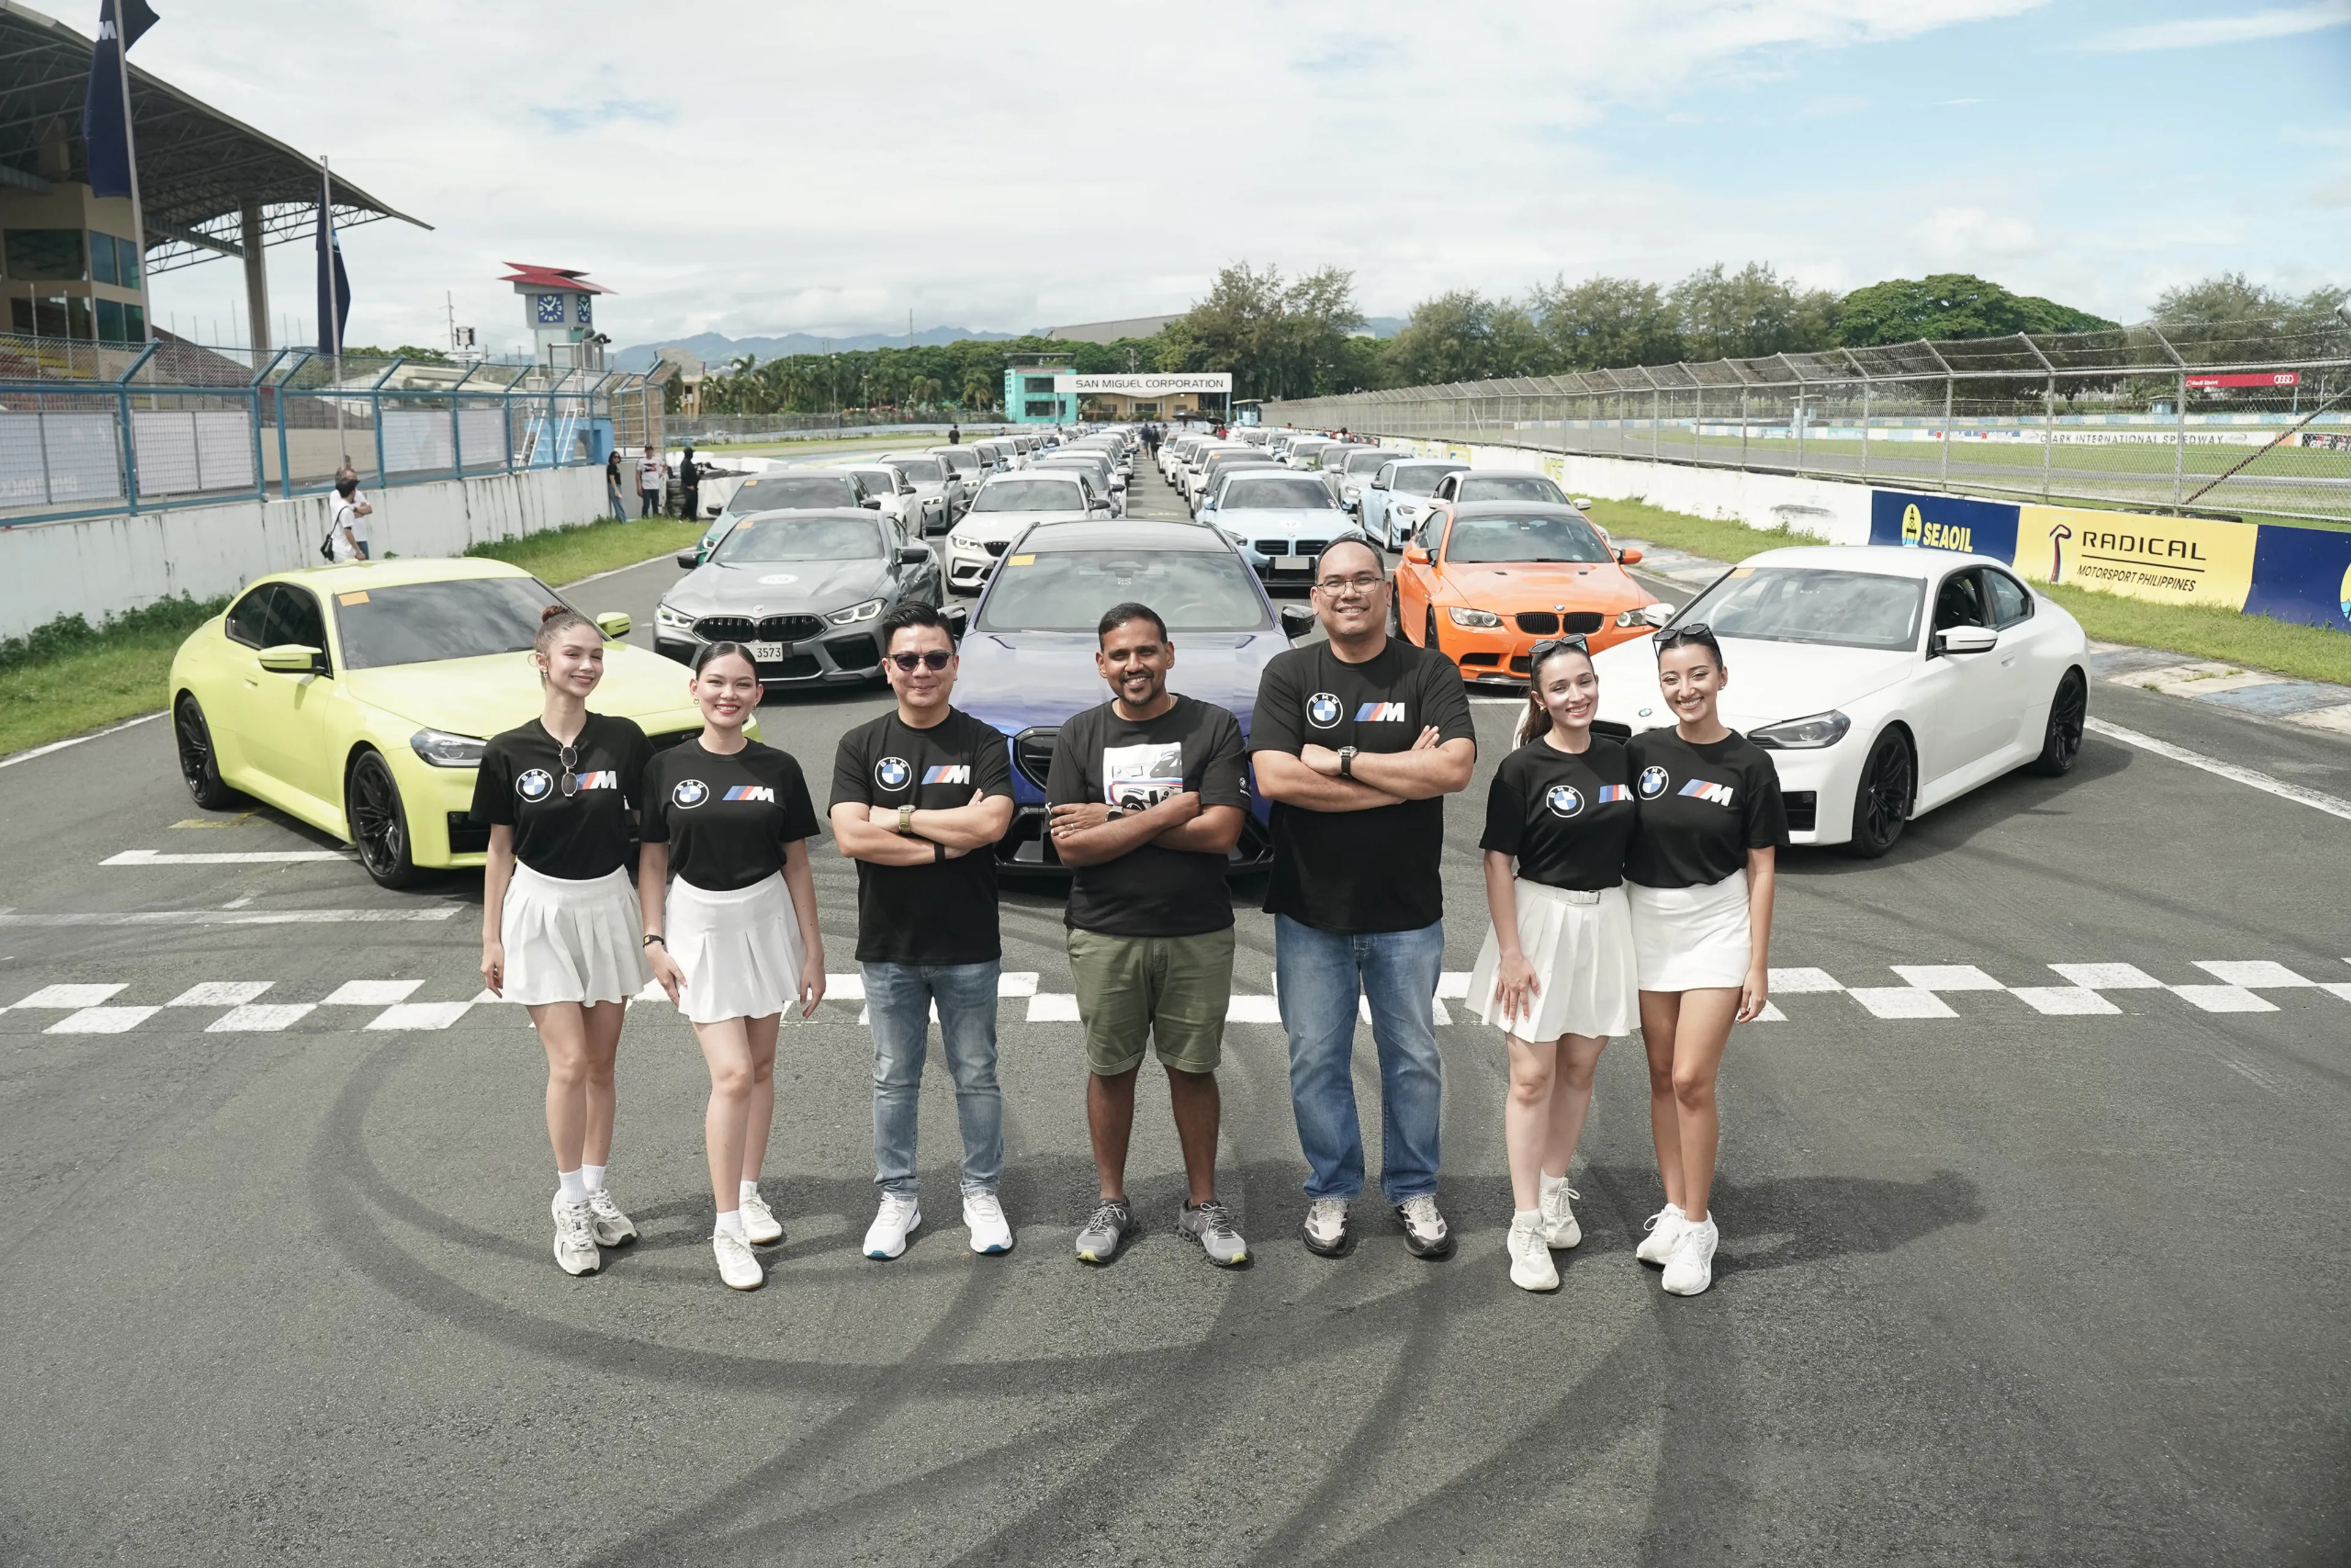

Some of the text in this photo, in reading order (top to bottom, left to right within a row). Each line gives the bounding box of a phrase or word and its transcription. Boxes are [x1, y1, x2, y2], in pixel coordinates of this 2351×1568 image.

[1076, 379, 1223, 388] SAN MIGUEL CORPORATION
[2040, 434, 2072, 443] CARK
[2076, 434, 2157, 444] INTERNATIONAL
[2163, 435, 2224, 445] SPEDWAY
[1923, 522, 1973, 553] SEAOIL
[2083, 531, 2207, 561] RADICAL
[2077, 565, 2197, 592] MOTORSPORT PHILIPPINES
[757, 647, 781, 658] 3573
[1377, 702, 1404, 722] M
[589, 770, 617, 790] M
[940, 765, 970, 784] M
[745, 786, 774, 804] M
[1699, 782, 1734, 807] M
